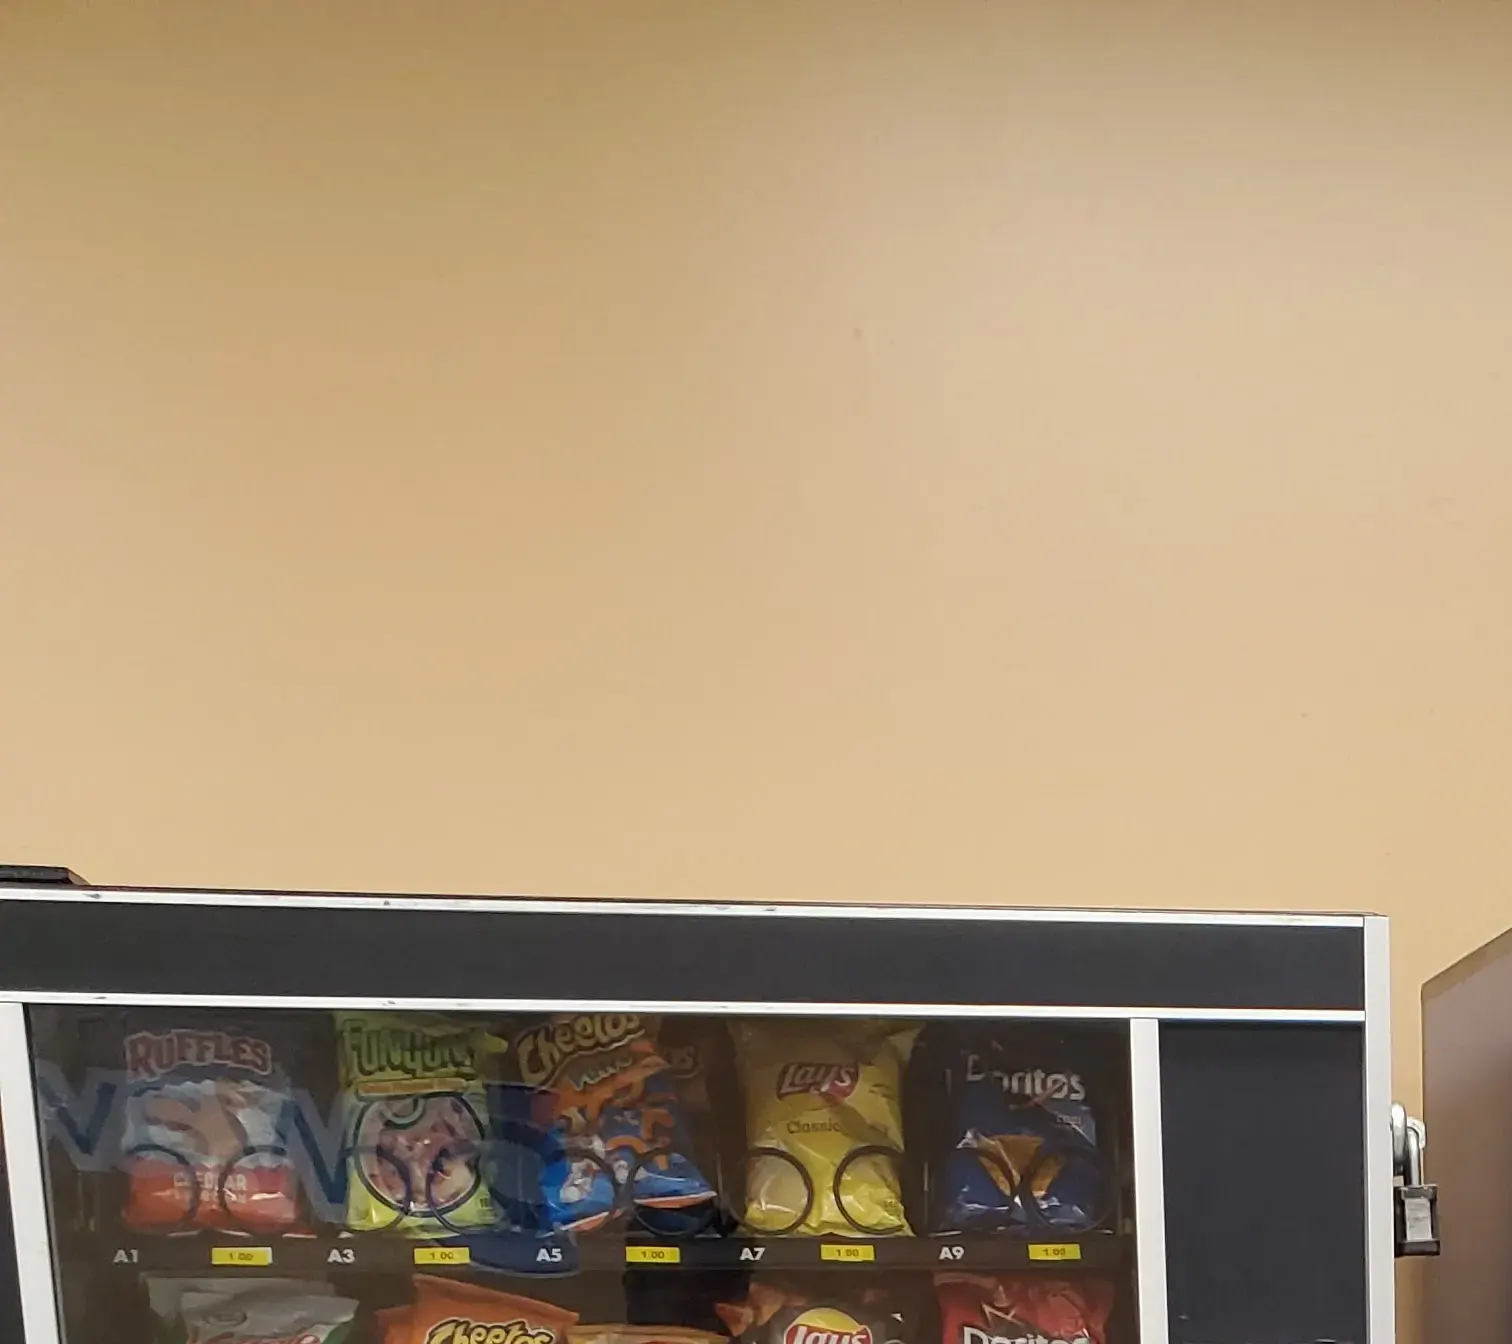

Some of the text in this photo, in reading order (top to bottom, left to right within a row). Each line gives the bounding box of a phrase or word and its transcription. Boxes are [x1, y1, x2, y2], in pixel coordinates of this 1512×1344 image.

[123, 1028, 273, 1083] RUFFLES
[780, 1060, 858, 1097] Lay's
[113, 1248, 139, 1263] A1
[327, 1248, 355, 1263] A3
[536, 1247, 562, 1262] A5
[739, 1246, 765, 1261] A7
[938, 1245, 965, 1261] A9
